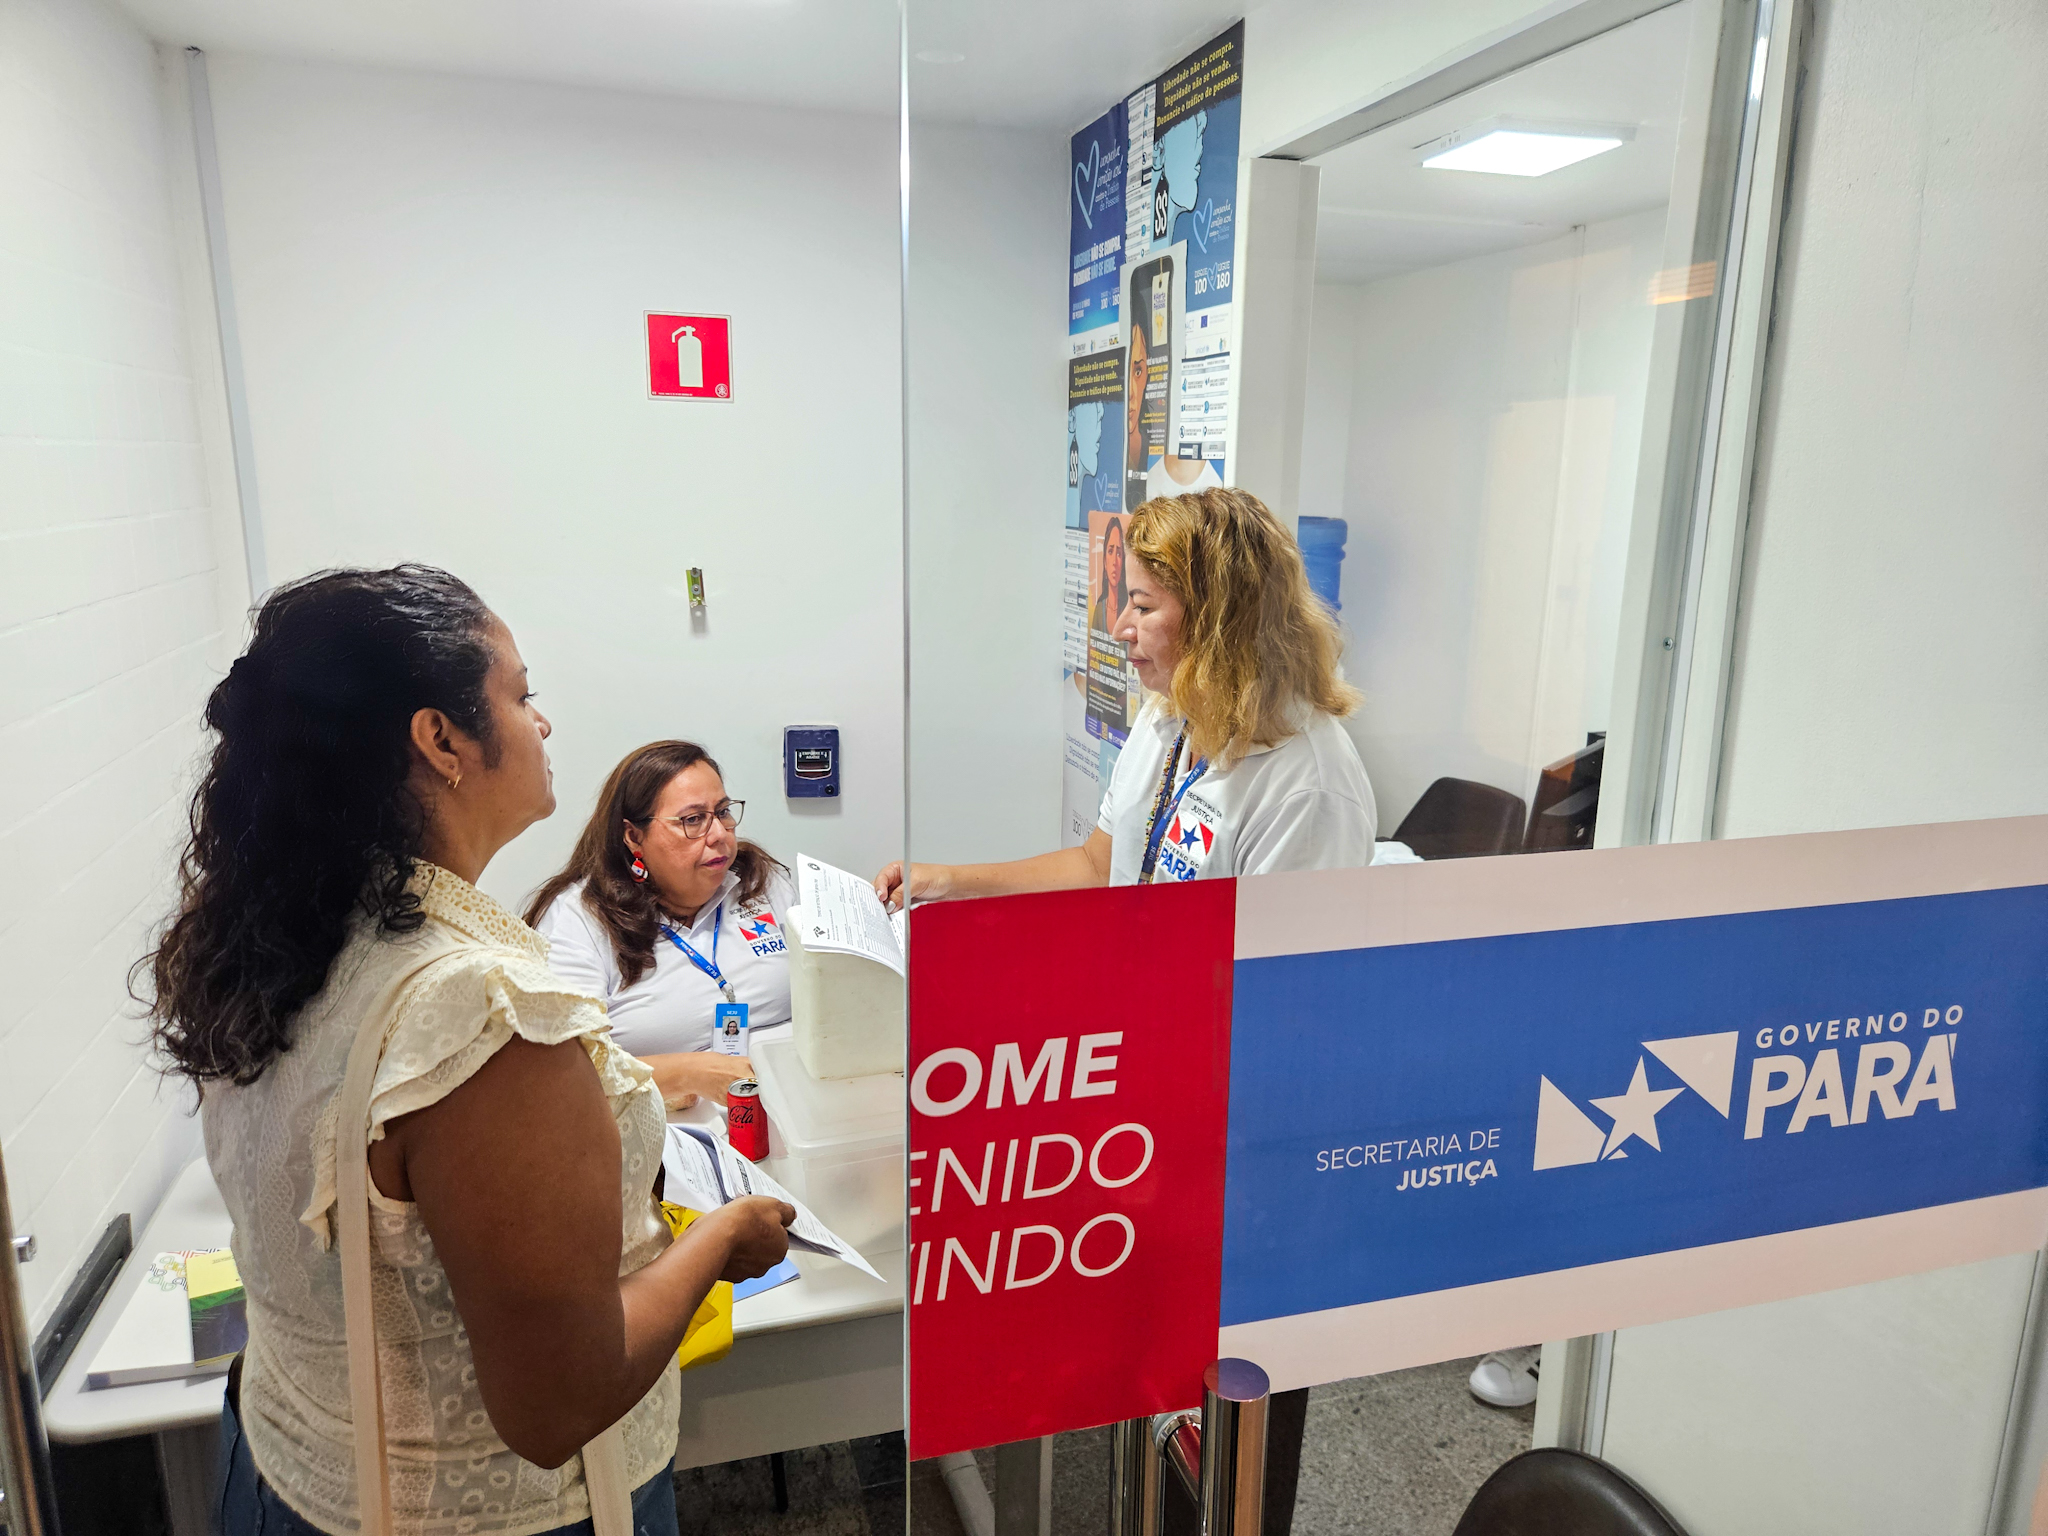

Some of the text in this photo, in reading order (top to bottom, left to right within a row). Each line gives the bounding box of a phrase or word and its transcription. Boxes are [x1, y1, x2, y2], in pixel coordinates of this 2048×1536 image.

[1163, 42, 1234, 93] Liberdade não se compra.
[1164, 60, 1231, 107] Dignidade não se vende.
[1156, 72, 1239, 127] Denuncie o tráfico de pessoas.
[1195, 277, 1207, 295] 100
[1216, 271, 1230, 289] 180
[1073, 363, 1091, 374] Liberdade
[1098, 361, 1103, 369] se
[1103, 359, 1119, 369] compra.
[1074, 375, 1093, 387] Dignidade
[1105, 370, 1118, 380] vende.
[1106, 384, 1123, 396] pessoas.
[1187, 767, 1200, 784] SEJU
[1186, 790, 1215, 814] SECRETARIA
[1216, 810, 1222, 819] DE
[1191, 805, 1213, 825] JUSTIÇA
[1073, 818, 1081, 837] 100
[1164, 840, 1200, 869] GOVERNO DO
[750, 936, 774, 946] GOVERNO
[1755, 1004, 1963, 1050] GOVERNO DO
[910, 1031, 1123, 1117] OME
[1744, 1033, 1957, 1140] PARÁ
[729, 1105, 753, 1124] Cola
[1315, 1127, 1501, 1172] SECRETARIA DE
[1396, 1158, 1498, 1192] JUSTIÇA
[910, 1213, 1135, 1305] INDO
